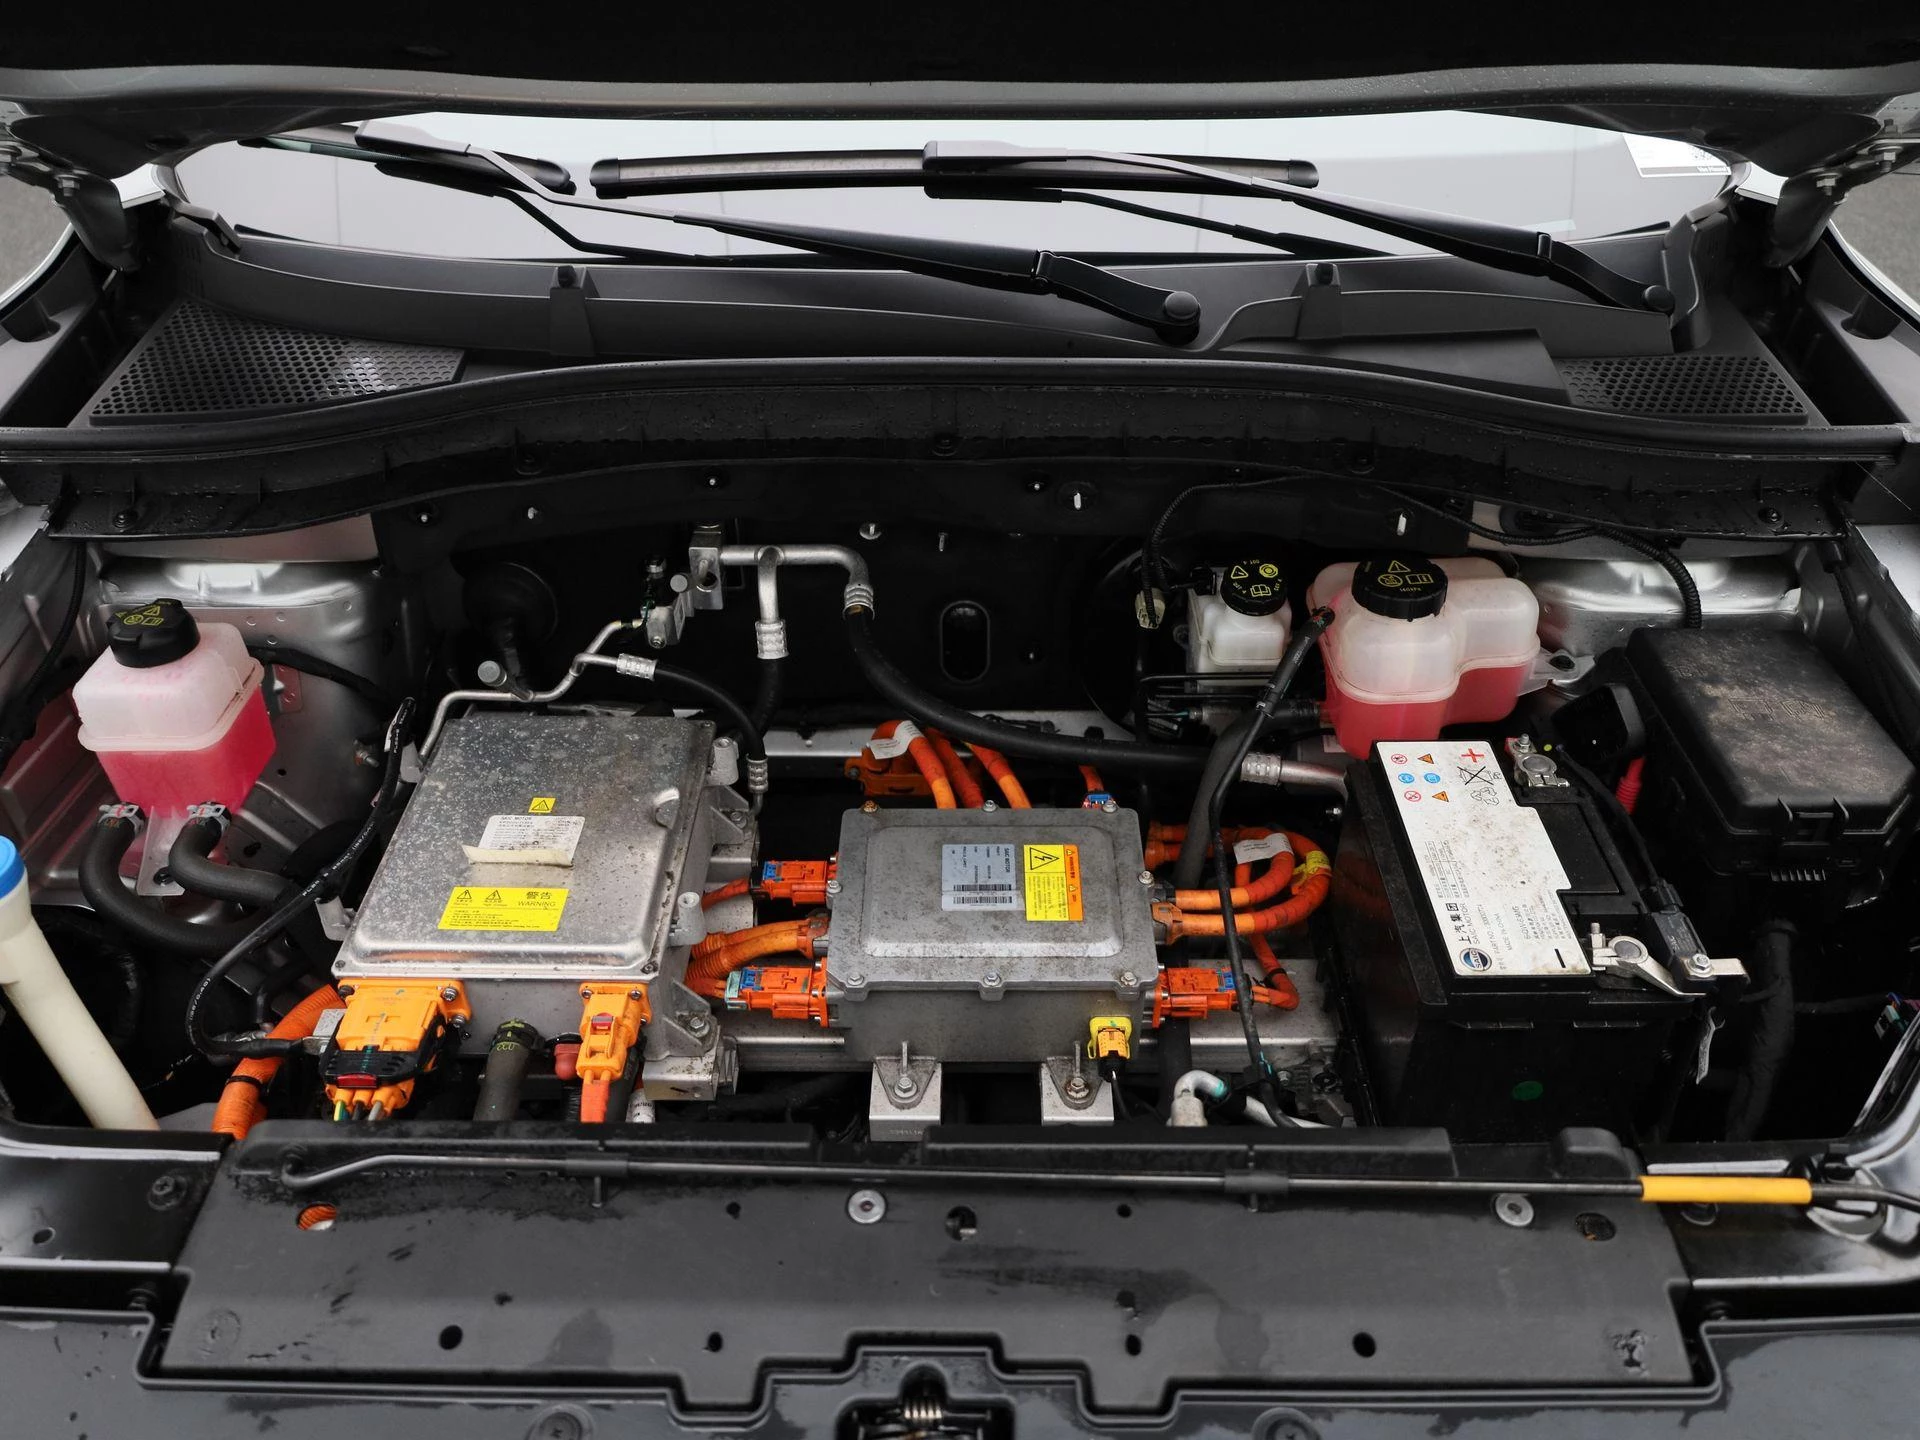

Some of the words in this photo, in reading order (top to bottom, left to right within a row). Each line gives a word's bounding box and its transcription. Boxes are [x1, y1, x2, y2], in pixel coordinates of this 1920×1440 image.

[1445, 903, 1471, 943] 上汽集团
[1458, 902, 1473, 925] MOTOR
[1468, 928, 1480, 943] SAIC
[1470, 950, 1482, 968] SAIC
